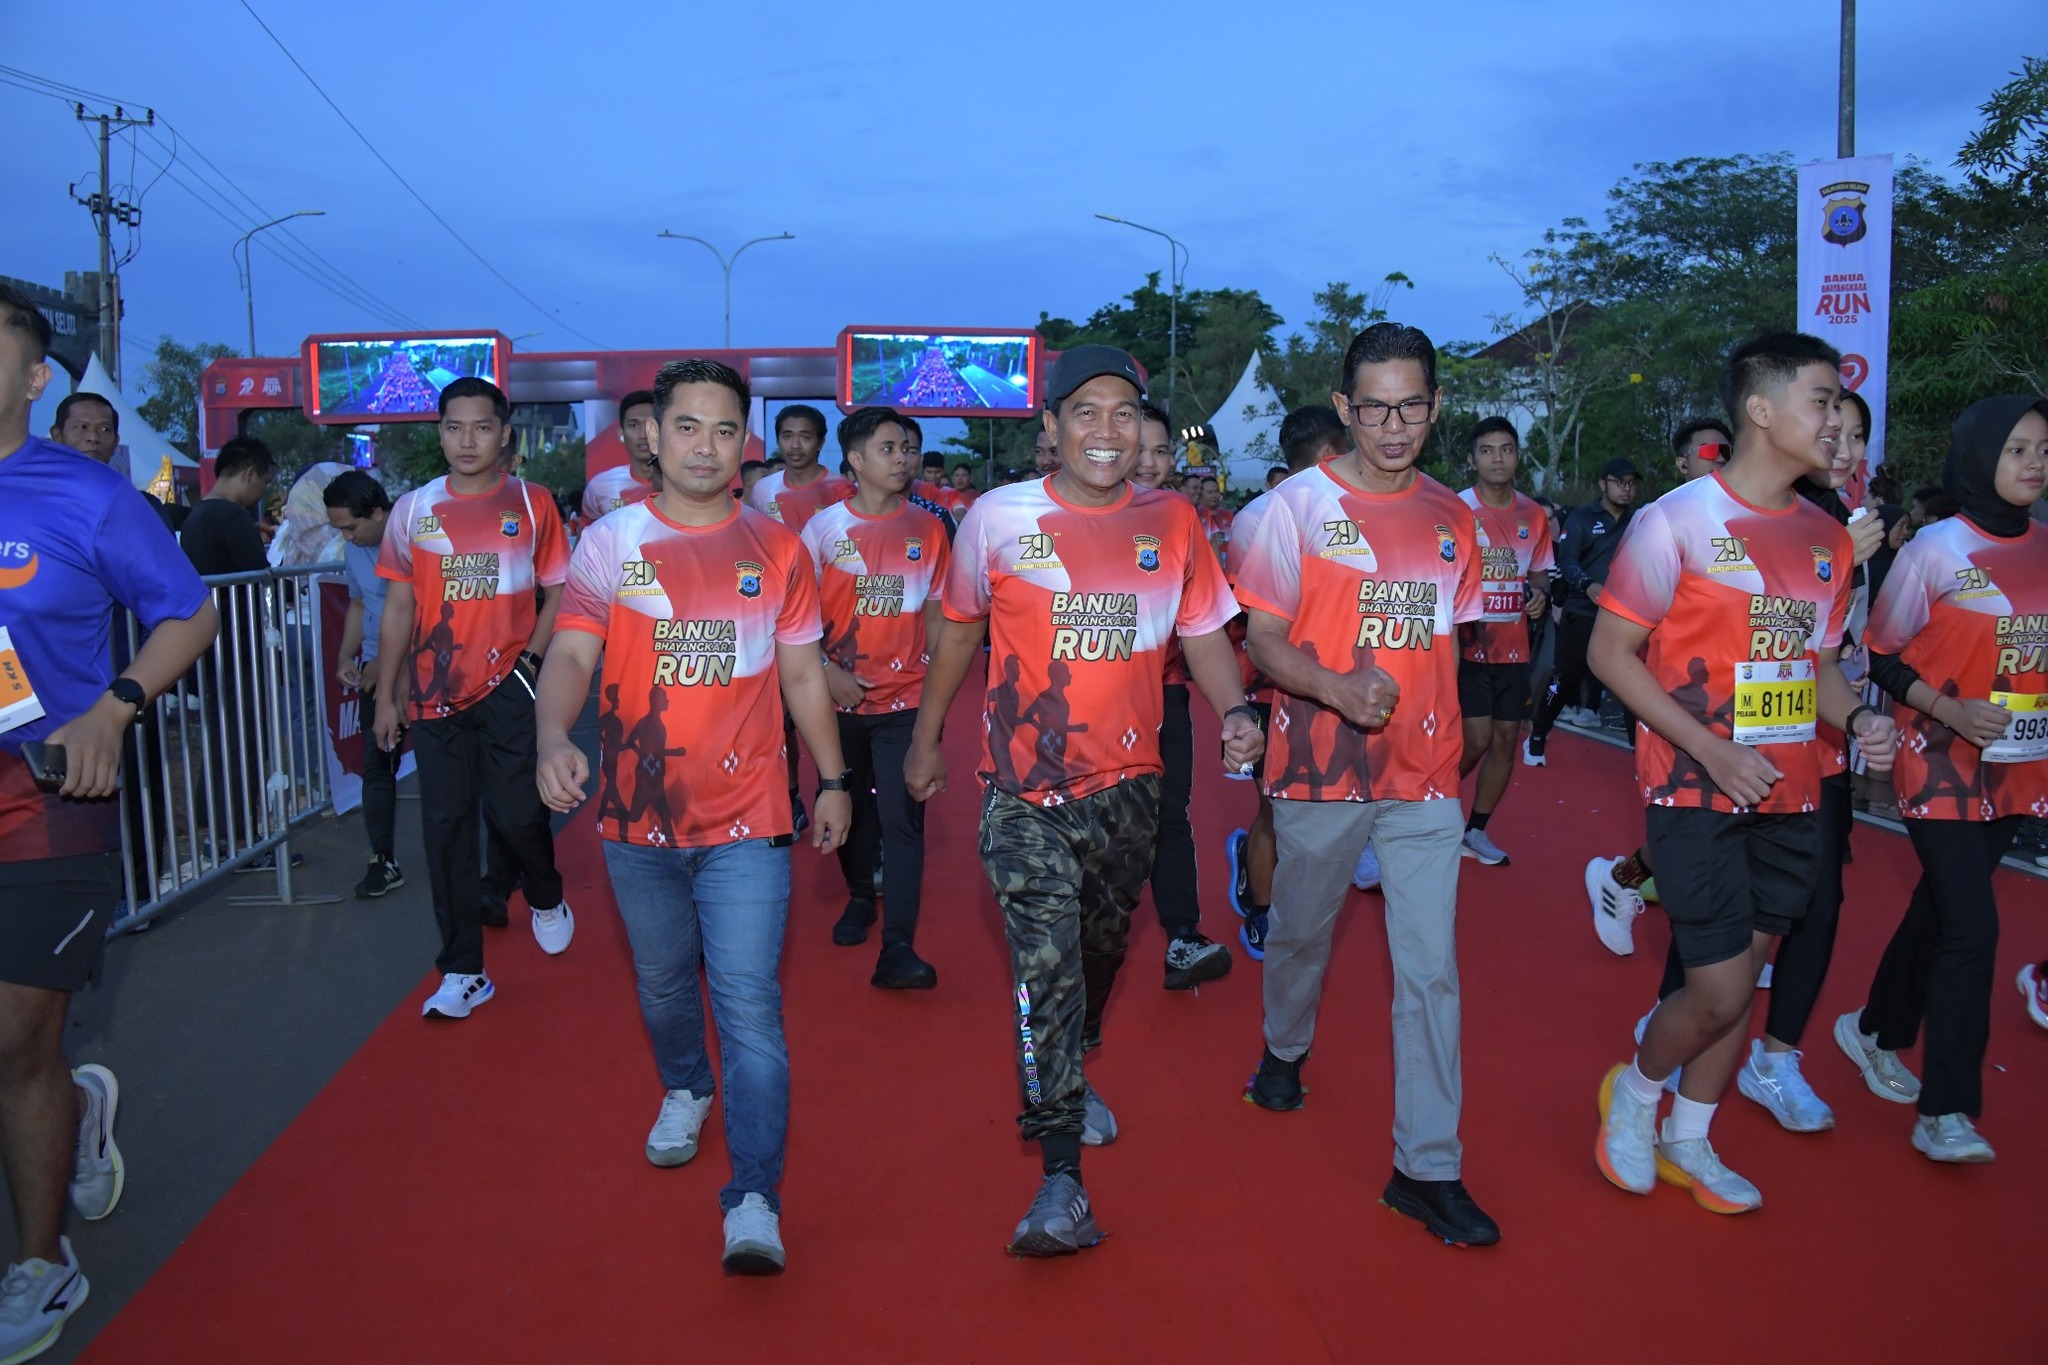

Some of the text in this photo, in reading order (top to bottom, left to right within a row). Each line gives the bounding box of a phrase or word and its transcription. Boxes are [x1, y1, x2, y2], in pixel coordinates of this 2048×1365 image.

[1821, 283, 1867, 293] BHAYANGKARA
[1824, 273, 1864, 283] BANUA
[1815, 292, 1871, 316] RUN
[1828, 315, 1858, 324] 2025
[441, 553, 500, 570] BANUA
[441, 568, 499, 578] BHAYANGKARA
[855, 574, 905, 589] BANUA
[1482, 564, 1519, 580] RUN
[442, 578, 499, 602] RUN
[1358, 580, 1437, 604] BANUA
[853, 597, 904, 617] RUN
[1051, 592, 1137, 615] BANUA
[1358, 602, 1436, 616] BHAYANGKARA
[1488, 596, 1513, 609] 7311
[1748, 594, 1816, 622] BANUA
[653, 619, 736, 641] BANUA
[1051, 615, 1136, 627] BHAYANGKARA
[1356, 615, 1435, 650] RUN
[653, 641, 736, 652] BHAYANGKARA
[1051, 628, 1137, 661] RUN
[1748, 629, 1812, 661] RUN
[653, 653, 736, 686] RUN
[1776, 669, 1793, 678] RUN
[1743, 694, 1752, 707] M
[1761, 689, 1804, 718] 8114
[2014, 717, 2048, 740] 993
[1020, 1016, 1036, 1065] NIKE
